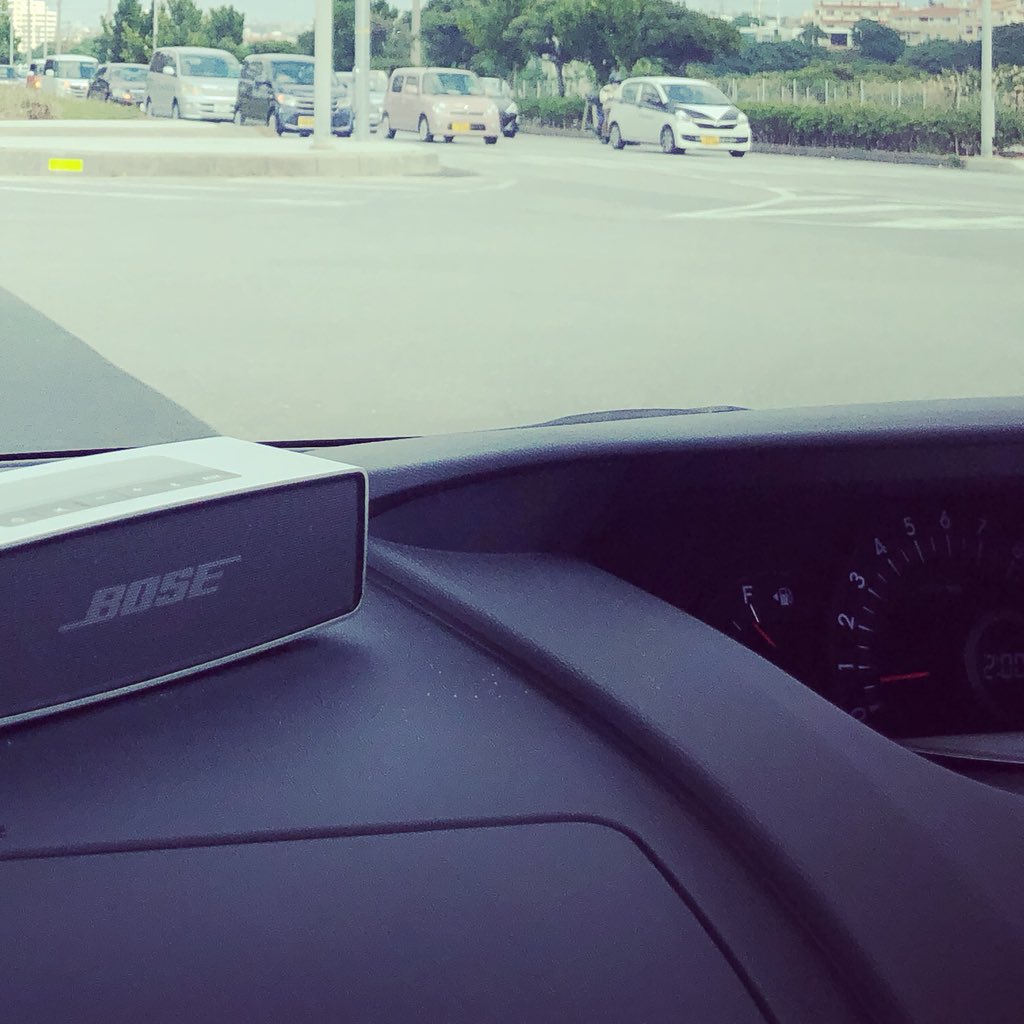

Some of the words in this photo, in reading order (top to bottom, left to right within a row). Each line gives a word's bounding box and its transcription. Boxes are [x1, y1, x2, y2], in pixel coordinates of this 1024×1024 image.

[903, 516, 916, 536] 5
[939, 510, 950, 529] 6
[874, 537, 888, 555] 4
[849, 572, 865, 589] 3
[58, 554, 242, 633] BOSE
[742, 585, 753, 605] F
[837, 613, 855, 630] 2
[837, 663, 855, 671] 1
